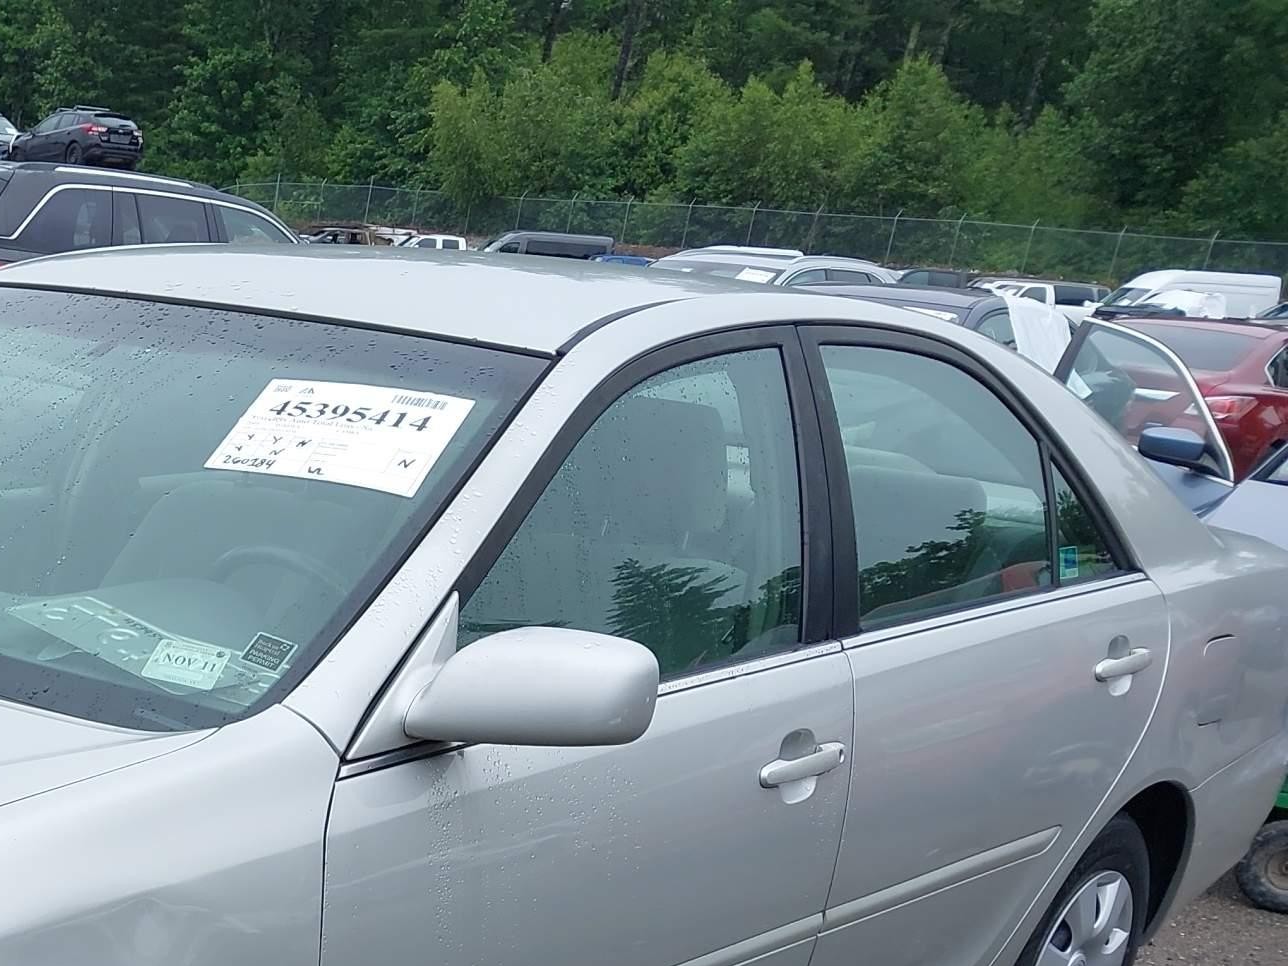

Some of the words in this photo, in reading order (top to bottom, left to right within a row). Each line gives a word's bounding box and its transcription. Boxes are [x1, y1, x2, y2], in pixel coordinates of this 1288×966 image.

[268, 399, 433, 432] 45395414
[161, 653, 199, 670] NOV
[247, 655, 276, 668] PERMIT
[249, 649, 281, 665] PARKING
